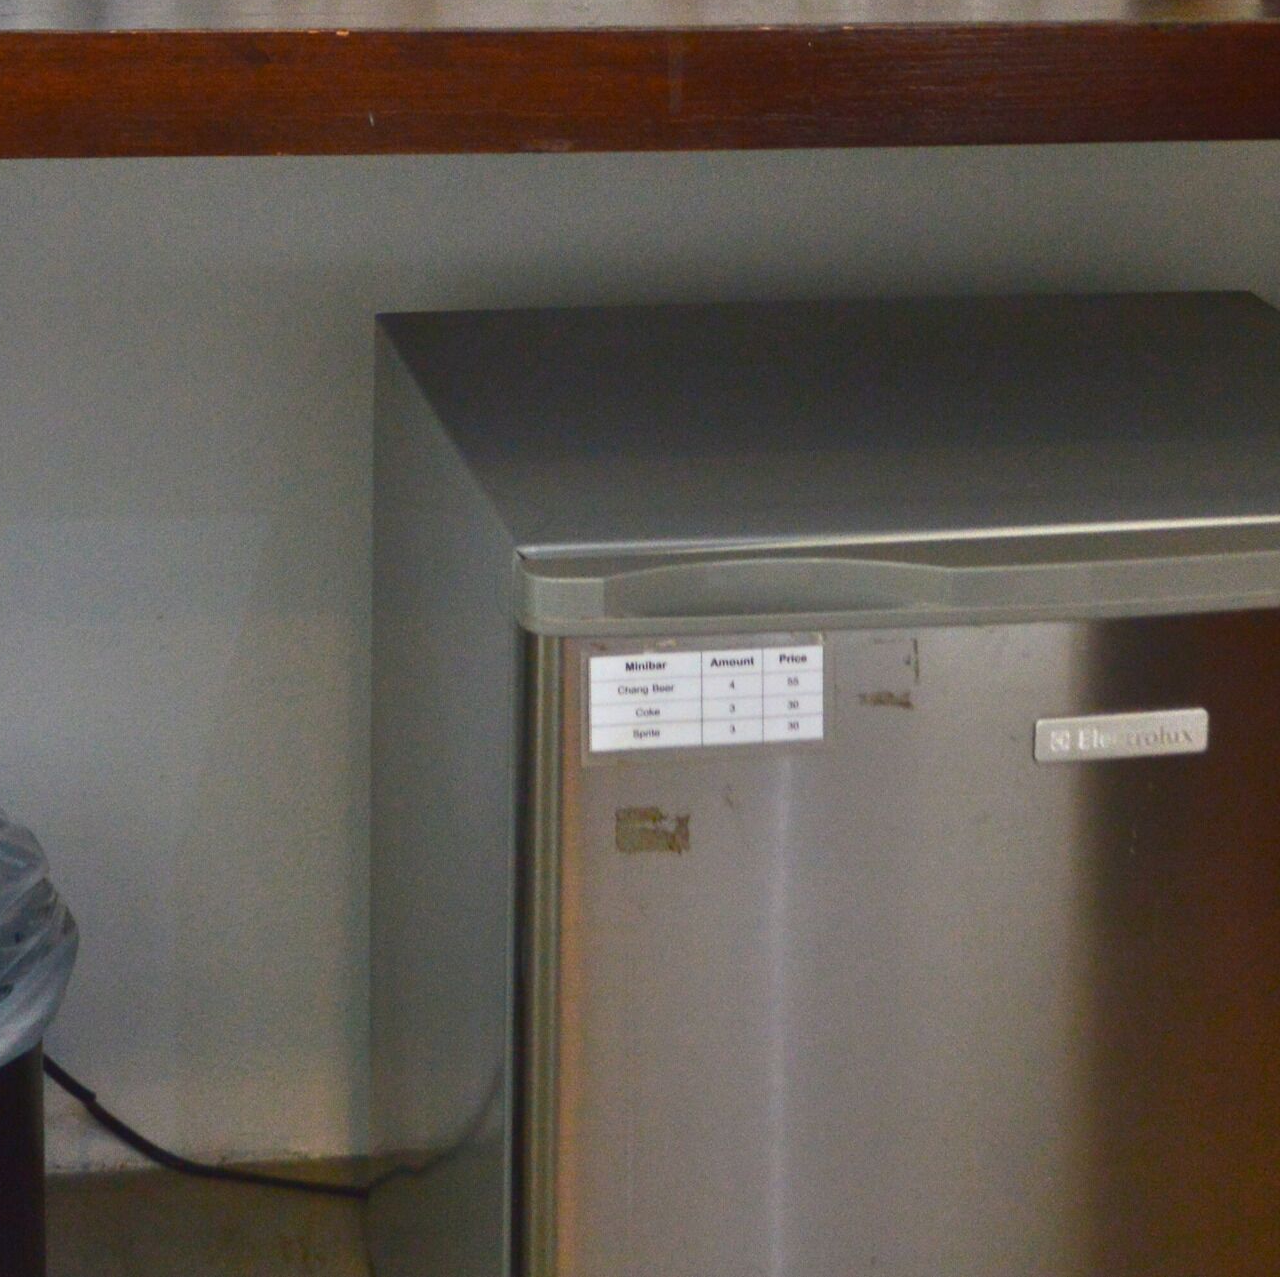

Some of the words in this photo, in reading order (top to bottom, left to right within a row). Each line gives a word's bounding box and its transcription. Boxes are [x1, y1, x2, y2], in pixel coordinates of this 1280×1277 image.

[625, 661, 667, 672] Minibar
[710, 656, 754, 667] Amount
[778, 653, 808, 664] Price
[617, 685, 649, 696] Chang
[652, 683, 674, 693] Beer
[635, 707, 661, 717] Coke
[729, 703, 736, 713] 3
[787, 699, 799, 709] 30
[632, 729, 660, 739] Sprite
[729, 725, 736, 734] 3
[788, 721, 800, 731] 30
